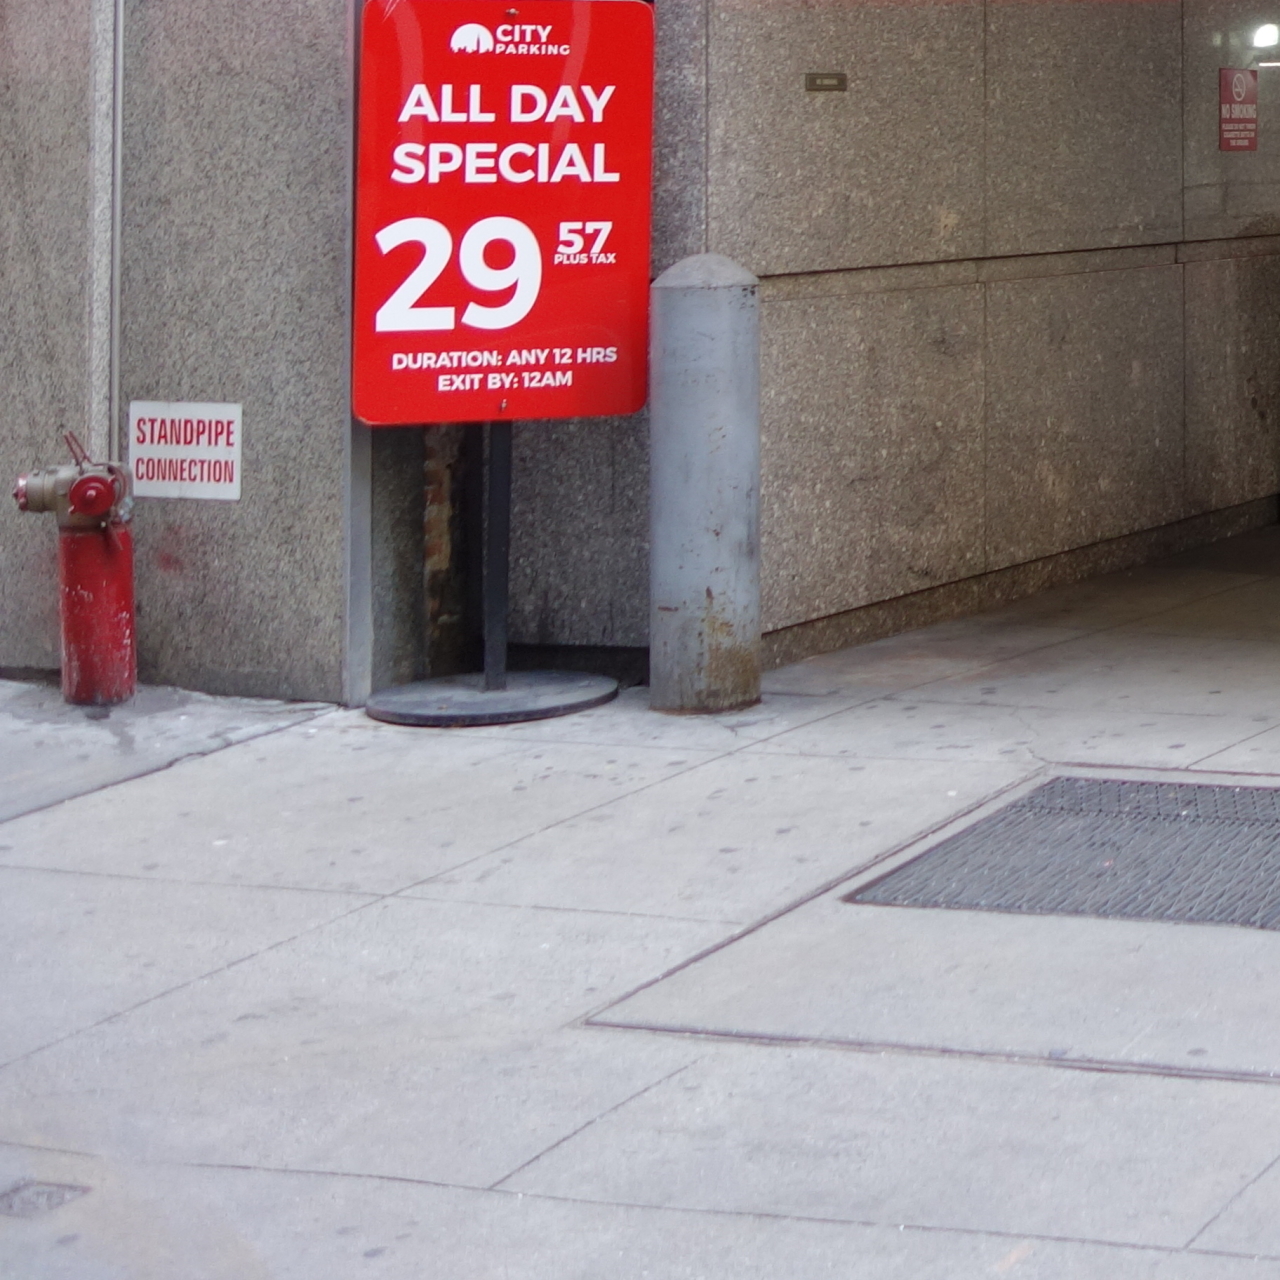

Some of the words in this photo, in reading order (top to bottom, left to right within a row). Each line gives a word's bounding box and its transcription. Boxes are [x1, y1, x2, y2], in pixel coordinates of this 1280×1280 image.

[495, 24, 552, 43] CITY
[495, 43, 570, 55] PARKING
[397, 83, 496, 123] ALL
[510, 84, 616, 123] DAY
[1221, 104, 1230, 119] NO
[1231, 104, 1257, 119] SMOKING
[390, 142, 620, 184] SPECIAL
[554, 252, 588, 265] PLUS
[590, 252, 616, 264] TAX
[375, 215, 543, 332] 29
[556, 221, 613, 254] 57
[392, 350, 502, 370] DURATION:
[506, 348, 549, 366] ANY
[553, 348, 573, 364] 12
[577, 347, 618, 364] HRS
[438, 373, 483, 391] EXIT
[487, 372, 519, 389] BY:
[522, 370, 573, 388] 12AM
[136, 417, 235, 448] STANDPIPE
[135, 457, 234, 484] CONNECTION
